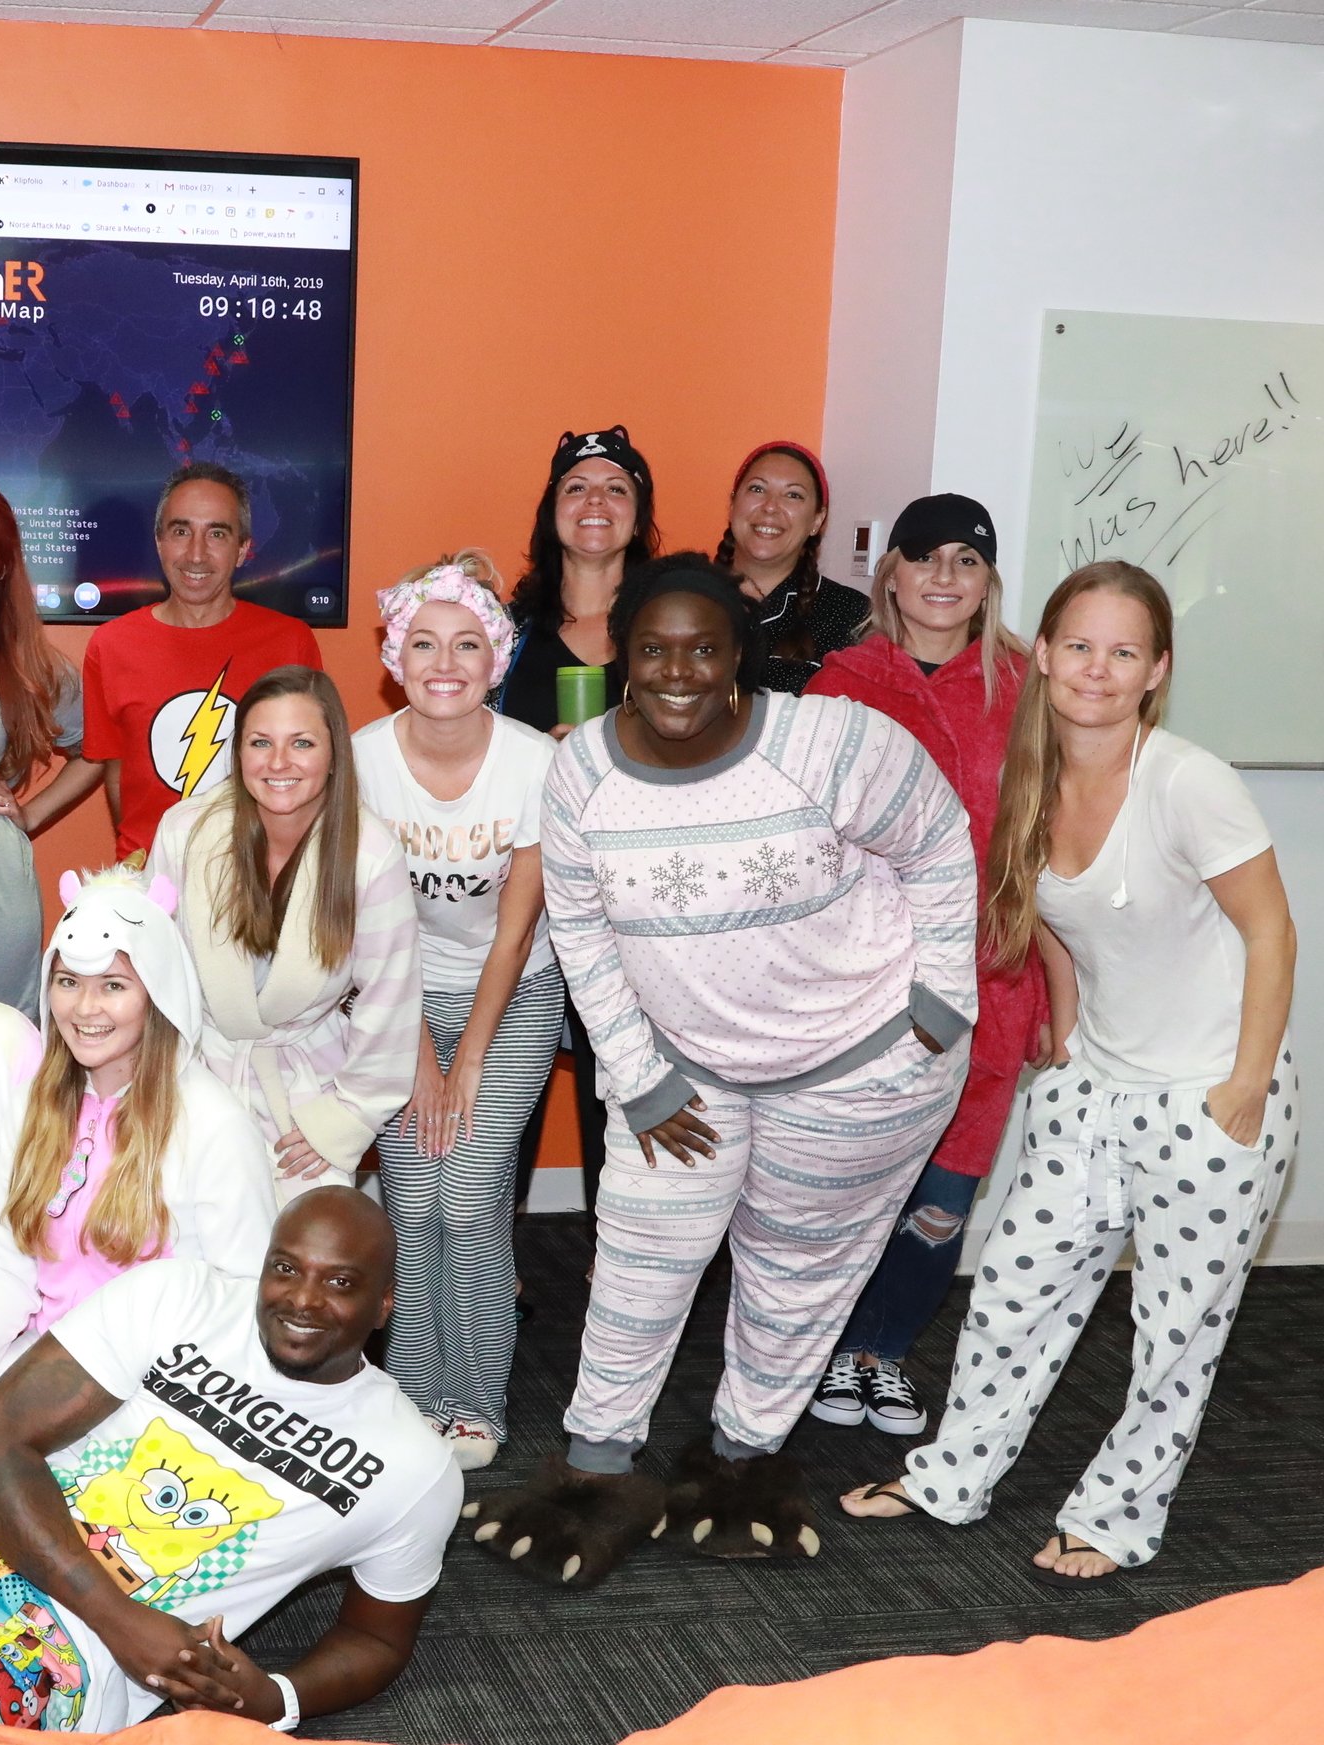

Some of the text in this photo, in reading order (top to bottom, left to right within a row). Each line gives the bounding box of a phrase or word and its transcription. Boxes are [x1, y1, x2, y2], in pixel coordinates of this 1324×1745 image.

[14, 177, 44, 185] Klipfolio
[179, 184, 198, 192] Inbox
[9, 221, 30, 229] Norse
[56, 222, 72, 231] Map
[96, 224, 116, 232] Share
[124, 226, 152, 236] Meeting
[173, 272, 324, 290] Tuesday, April 16th, 2019
[0, 302, 45, 324] Map
[199, 296, 322, 321] 09:10:48
[48, 508, 80, 517] States
[29, 520, 62, 529] United
[66, 520, 98, 529] States
[21, 531, 90, 541] United States
[45, 543, 77, 552] States
[32, 555, 64, 564] States
[311, 595, 330, 605] 9:10
[383, 818, 516, 862] HOOSE
[156, 1342, 385, 1490] SPONGEBOB
